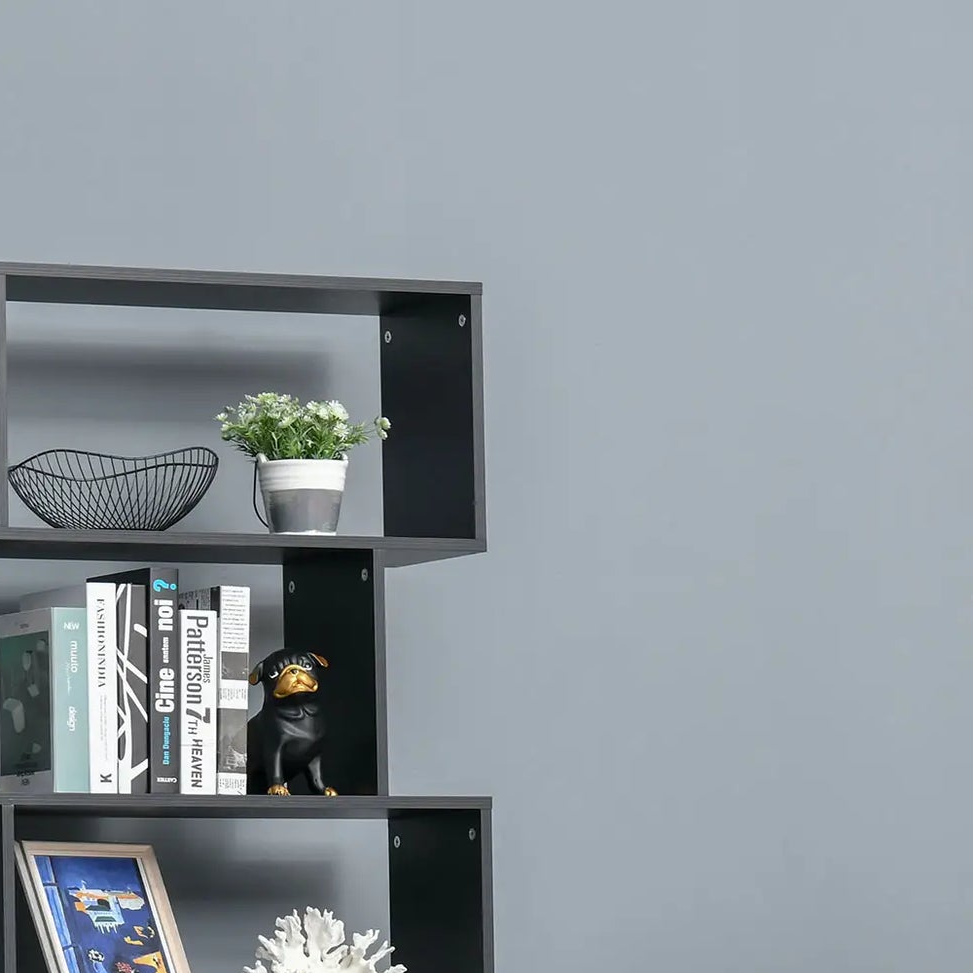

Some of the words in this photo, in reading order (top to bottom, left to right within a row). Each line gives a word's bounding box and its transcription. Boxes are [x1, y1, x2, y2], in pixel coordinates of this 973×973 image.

[63, 621, 80, 631] NEW
[154, 599, 174, 631] noi
[70, 640, 78, 673] muuto
[96, 598, 106, 688] FASHIONINDIA
[186, 615, 209, 705] Patterson
[203, 653, 214, 684] James
[154, 667, 175, 713] Cine
[66, 706, 76, 732] design
[162, 716, 171, 749] Dungaciu
[162, 751, 170, 765] Dan
[190, 738, 203, 788] HEAVEN
[100, 773, 112, 783] K
